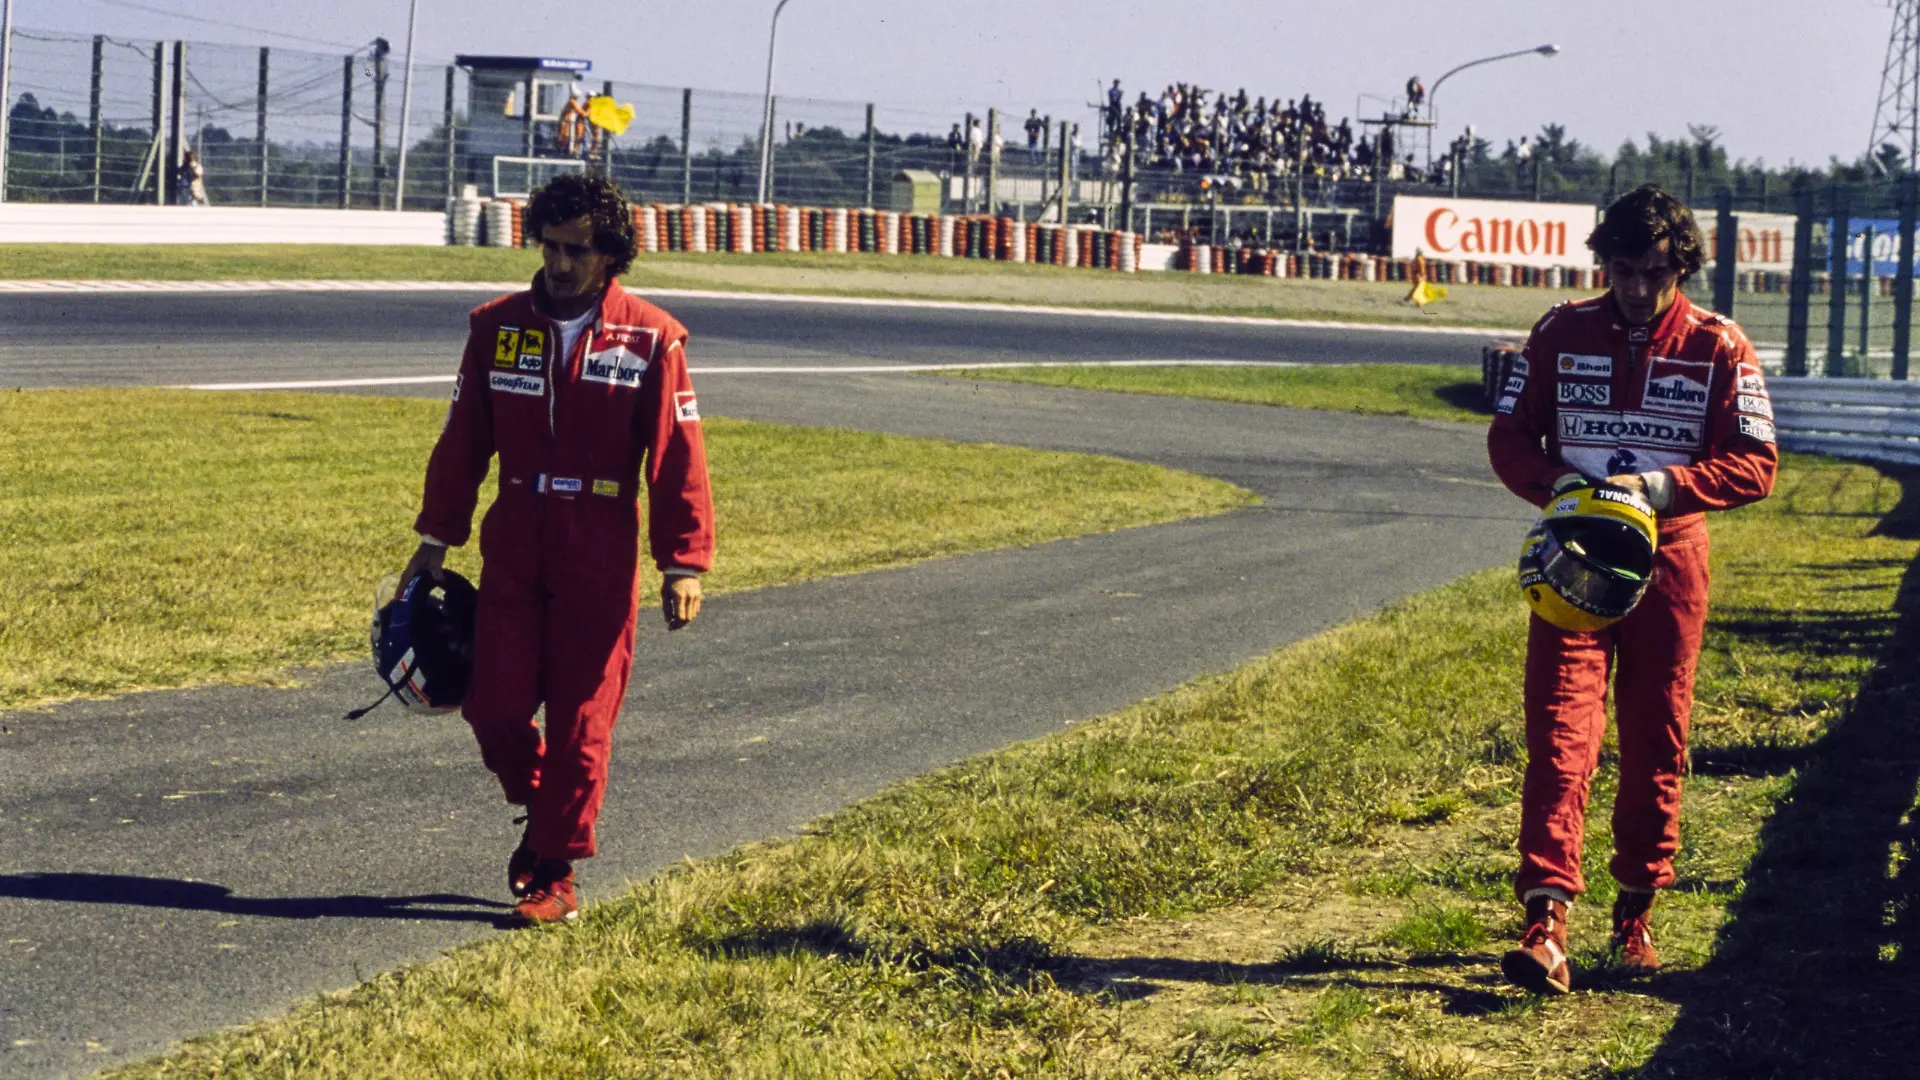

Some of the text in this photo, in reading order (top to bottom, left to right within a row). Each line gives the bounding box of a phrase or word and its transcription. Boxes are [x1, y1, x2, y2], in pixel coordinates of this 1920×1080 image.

[1424, 207, 1567, 256] Canon
[1577, 362, 1610, 372] Shell
[491, 376, 540, 391] GOODYEAR
[1560, 383, 1607, 402] BOSS
[1647, 380, 1706, 403] Marlboro
[1583, 420, 1699, 442] HONDA
